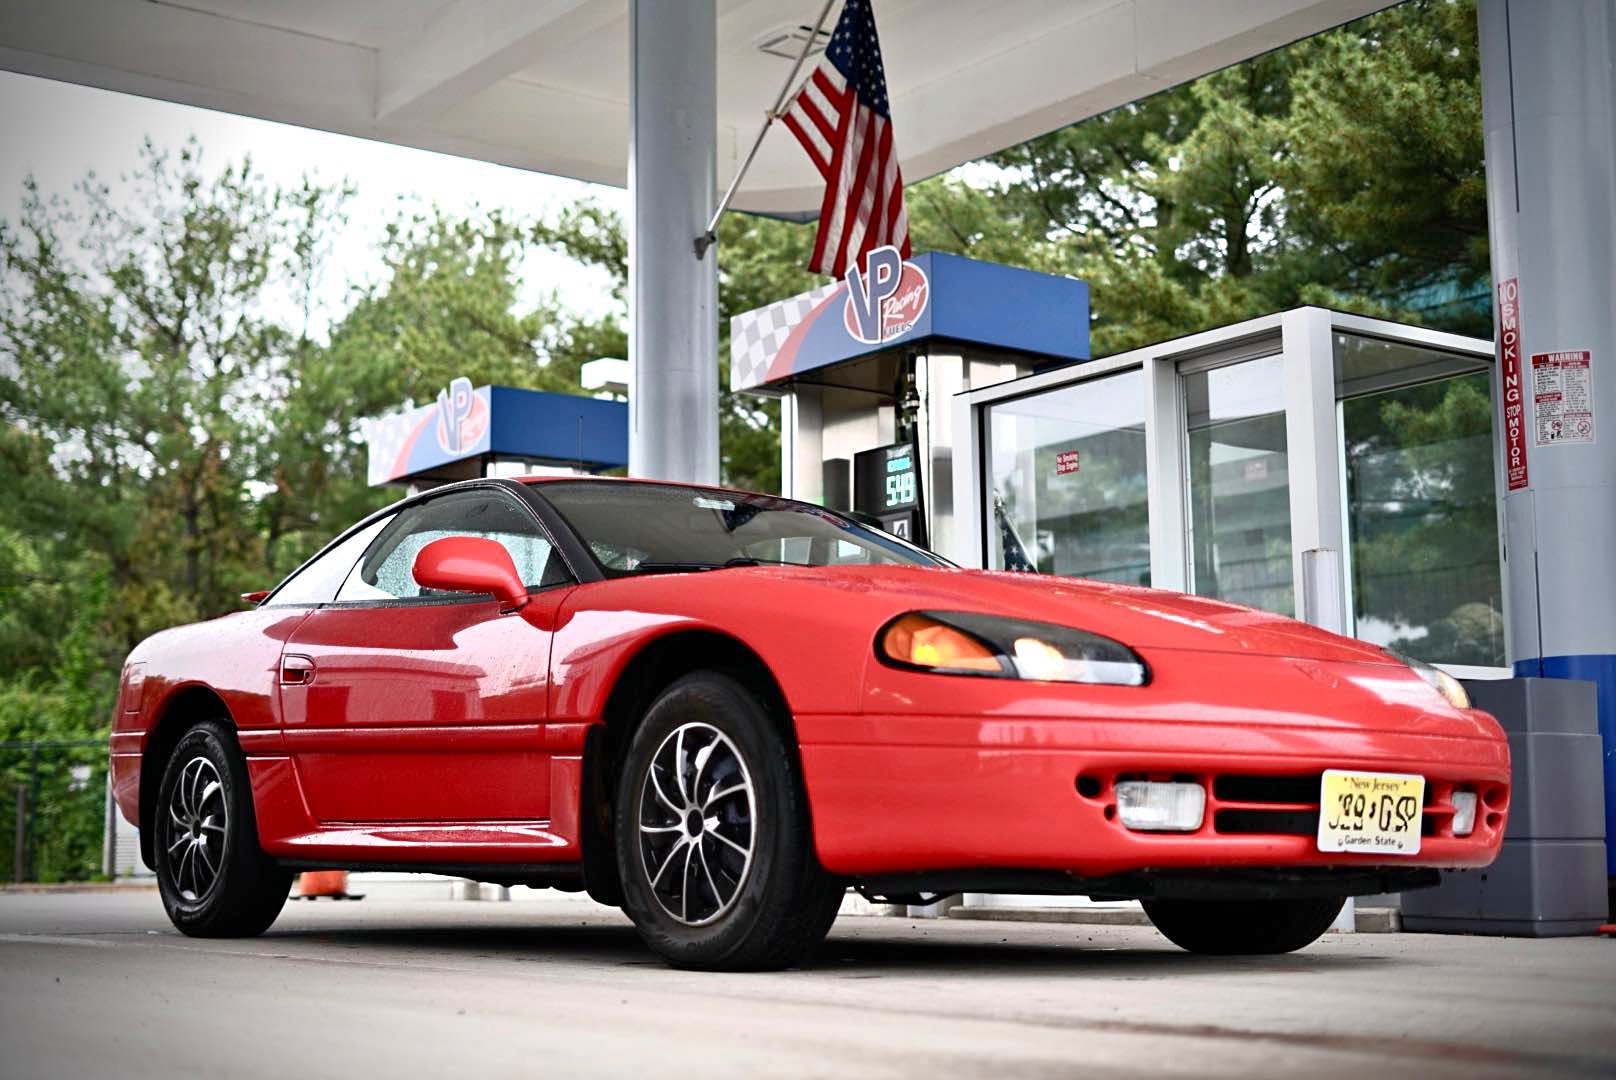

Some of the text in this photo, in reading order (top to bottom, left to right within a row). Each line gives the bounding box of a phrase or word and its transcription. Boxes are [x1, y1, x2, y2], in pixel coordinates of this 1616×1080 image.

[845, 245, 902, 342] VP
[883, 284, 927, 319] Racing
[1500, 282, 1516, 304] NO
[883, 321, 912, 336] FUELS
[1502, 303, 1520, 402] SMOKING
[1548, 352, 1584, 362] WARNING
[437, 376, 474, 453] VP
[1506, 405, 1520, 418] STOP
[1508, 418, 1520, 466] MOTOR
[1350, 777, 1400, 792] New Jersey
[1344, 834, 1396, 846] Garden State
